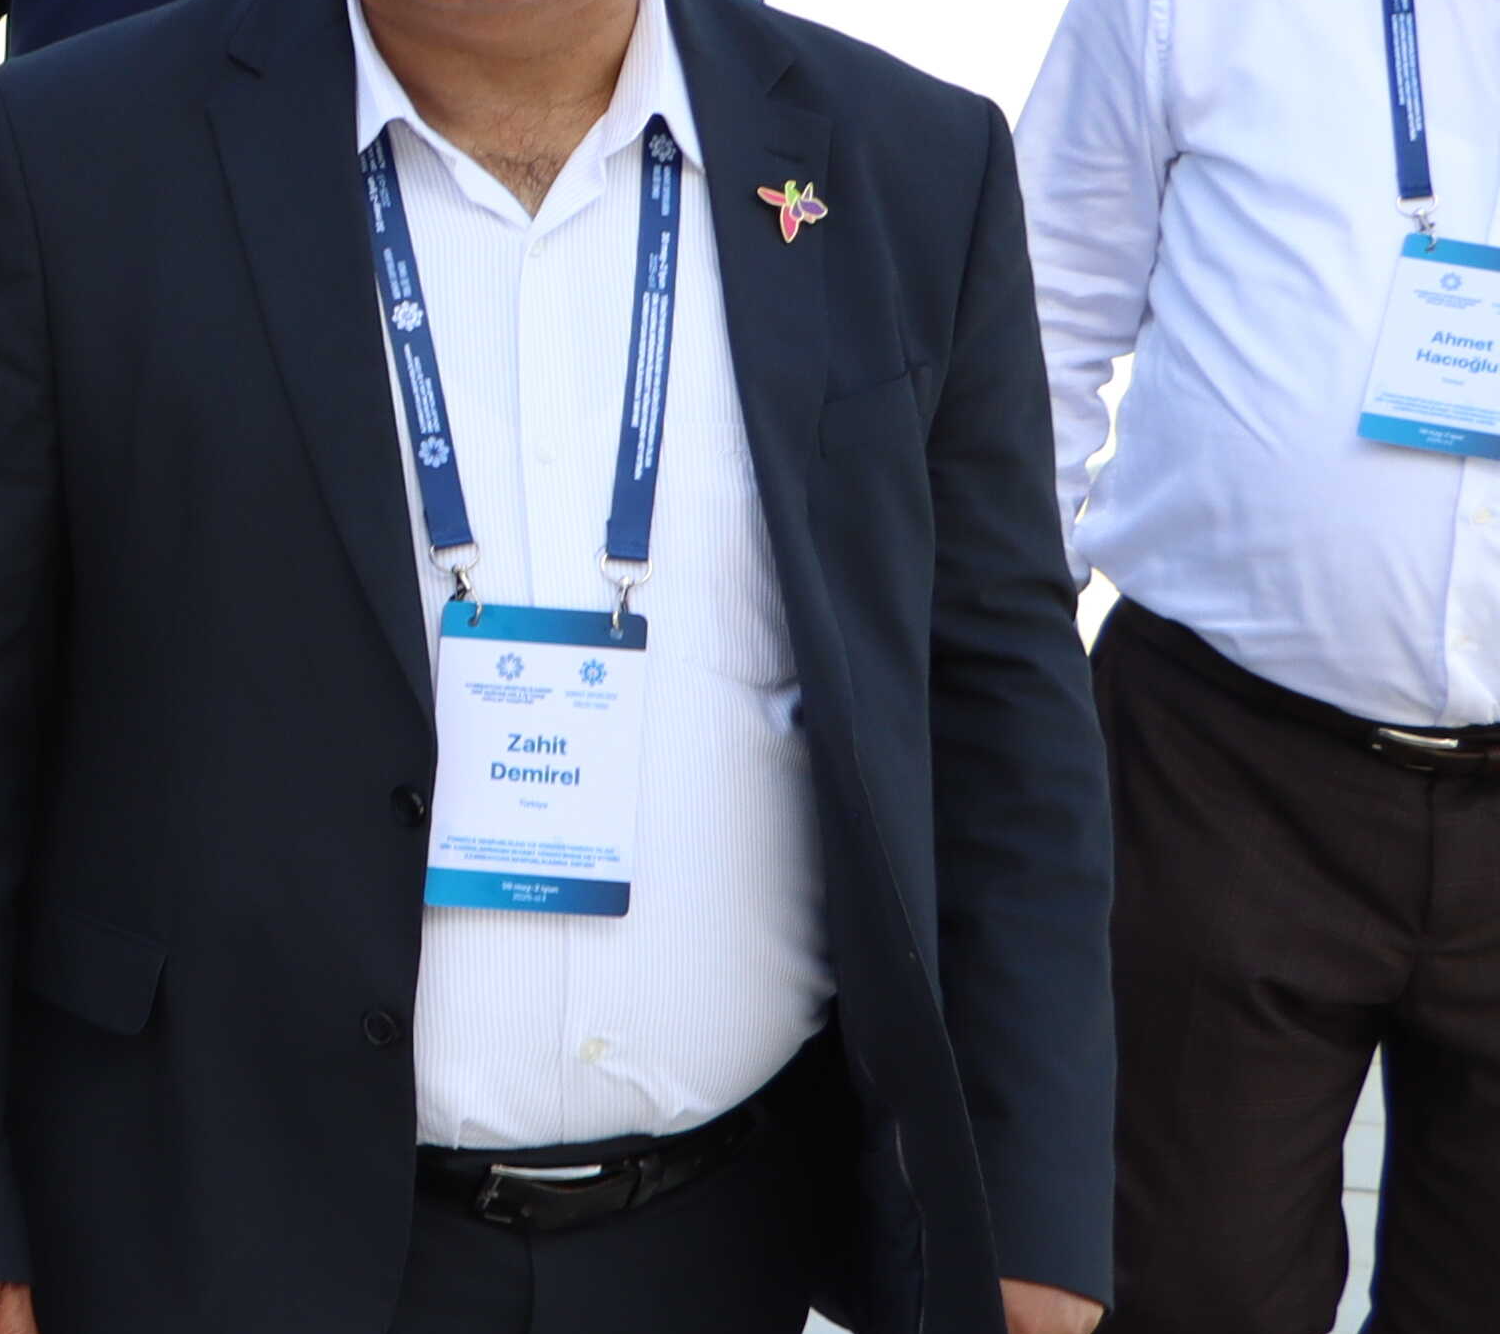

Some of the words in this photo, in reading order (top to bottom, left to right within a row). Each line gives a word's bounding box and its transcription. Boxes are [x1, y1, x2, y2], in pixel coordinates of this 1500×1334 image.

[1431, 331, 1494, 352] Ahmet
[507, 733, 567, 755] Zahit
[490, 761, 581, 787] Demirel
